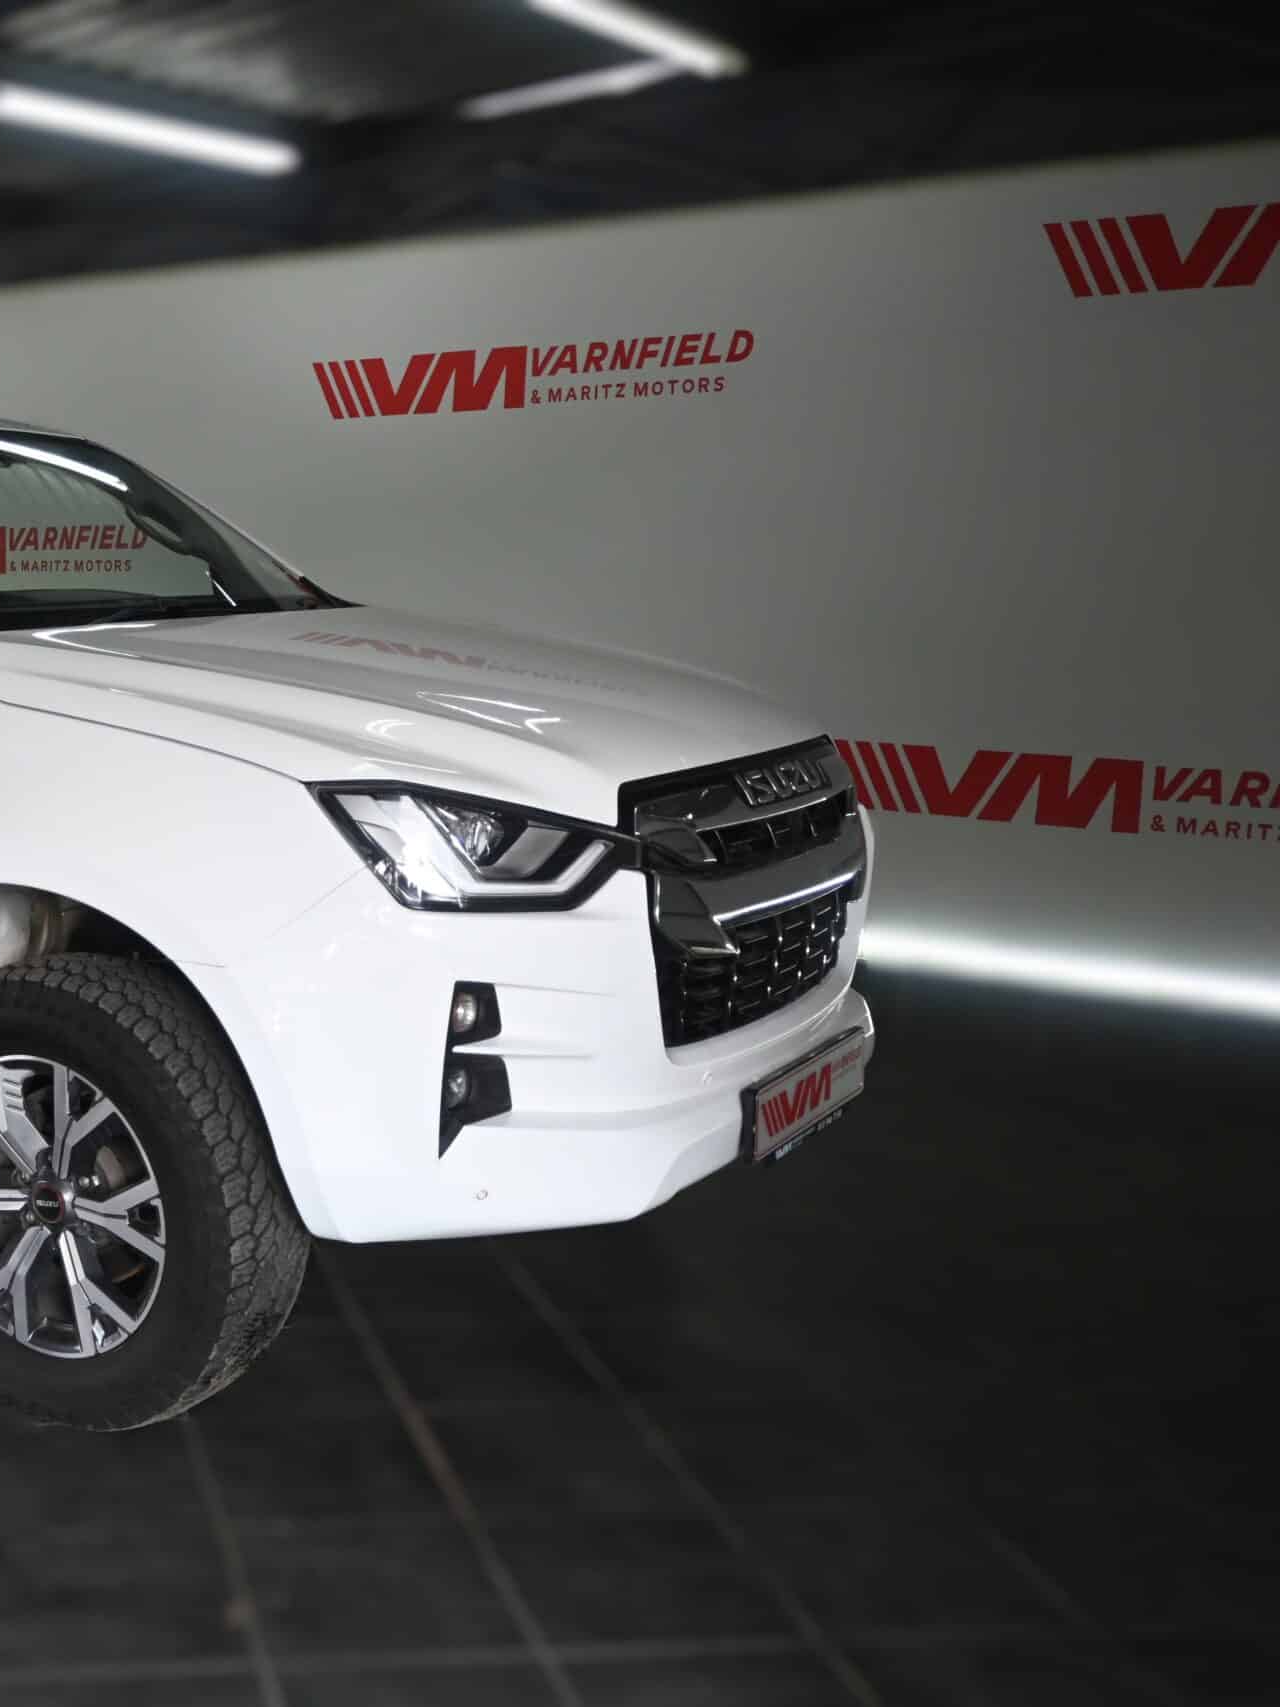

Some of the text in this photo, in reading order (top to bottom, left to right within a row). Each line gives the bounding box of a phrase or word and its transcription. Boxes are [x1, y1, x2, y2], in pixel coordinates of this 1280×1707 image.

[359, 329, 755, 417] VM VARNFIELD
[530, 376, 727, 404] & MARITZ MOTORS
[8, 525, 149, 551] VARNFIELD
[21, 560, 70, 572] MARITZ
[74, 559, 133, 573] MOTORS
[734, 759, 829, 807] ISUZU
[901, 743, 1144, 834] VM
[1150, 814, 1280, 842] & MARIT
